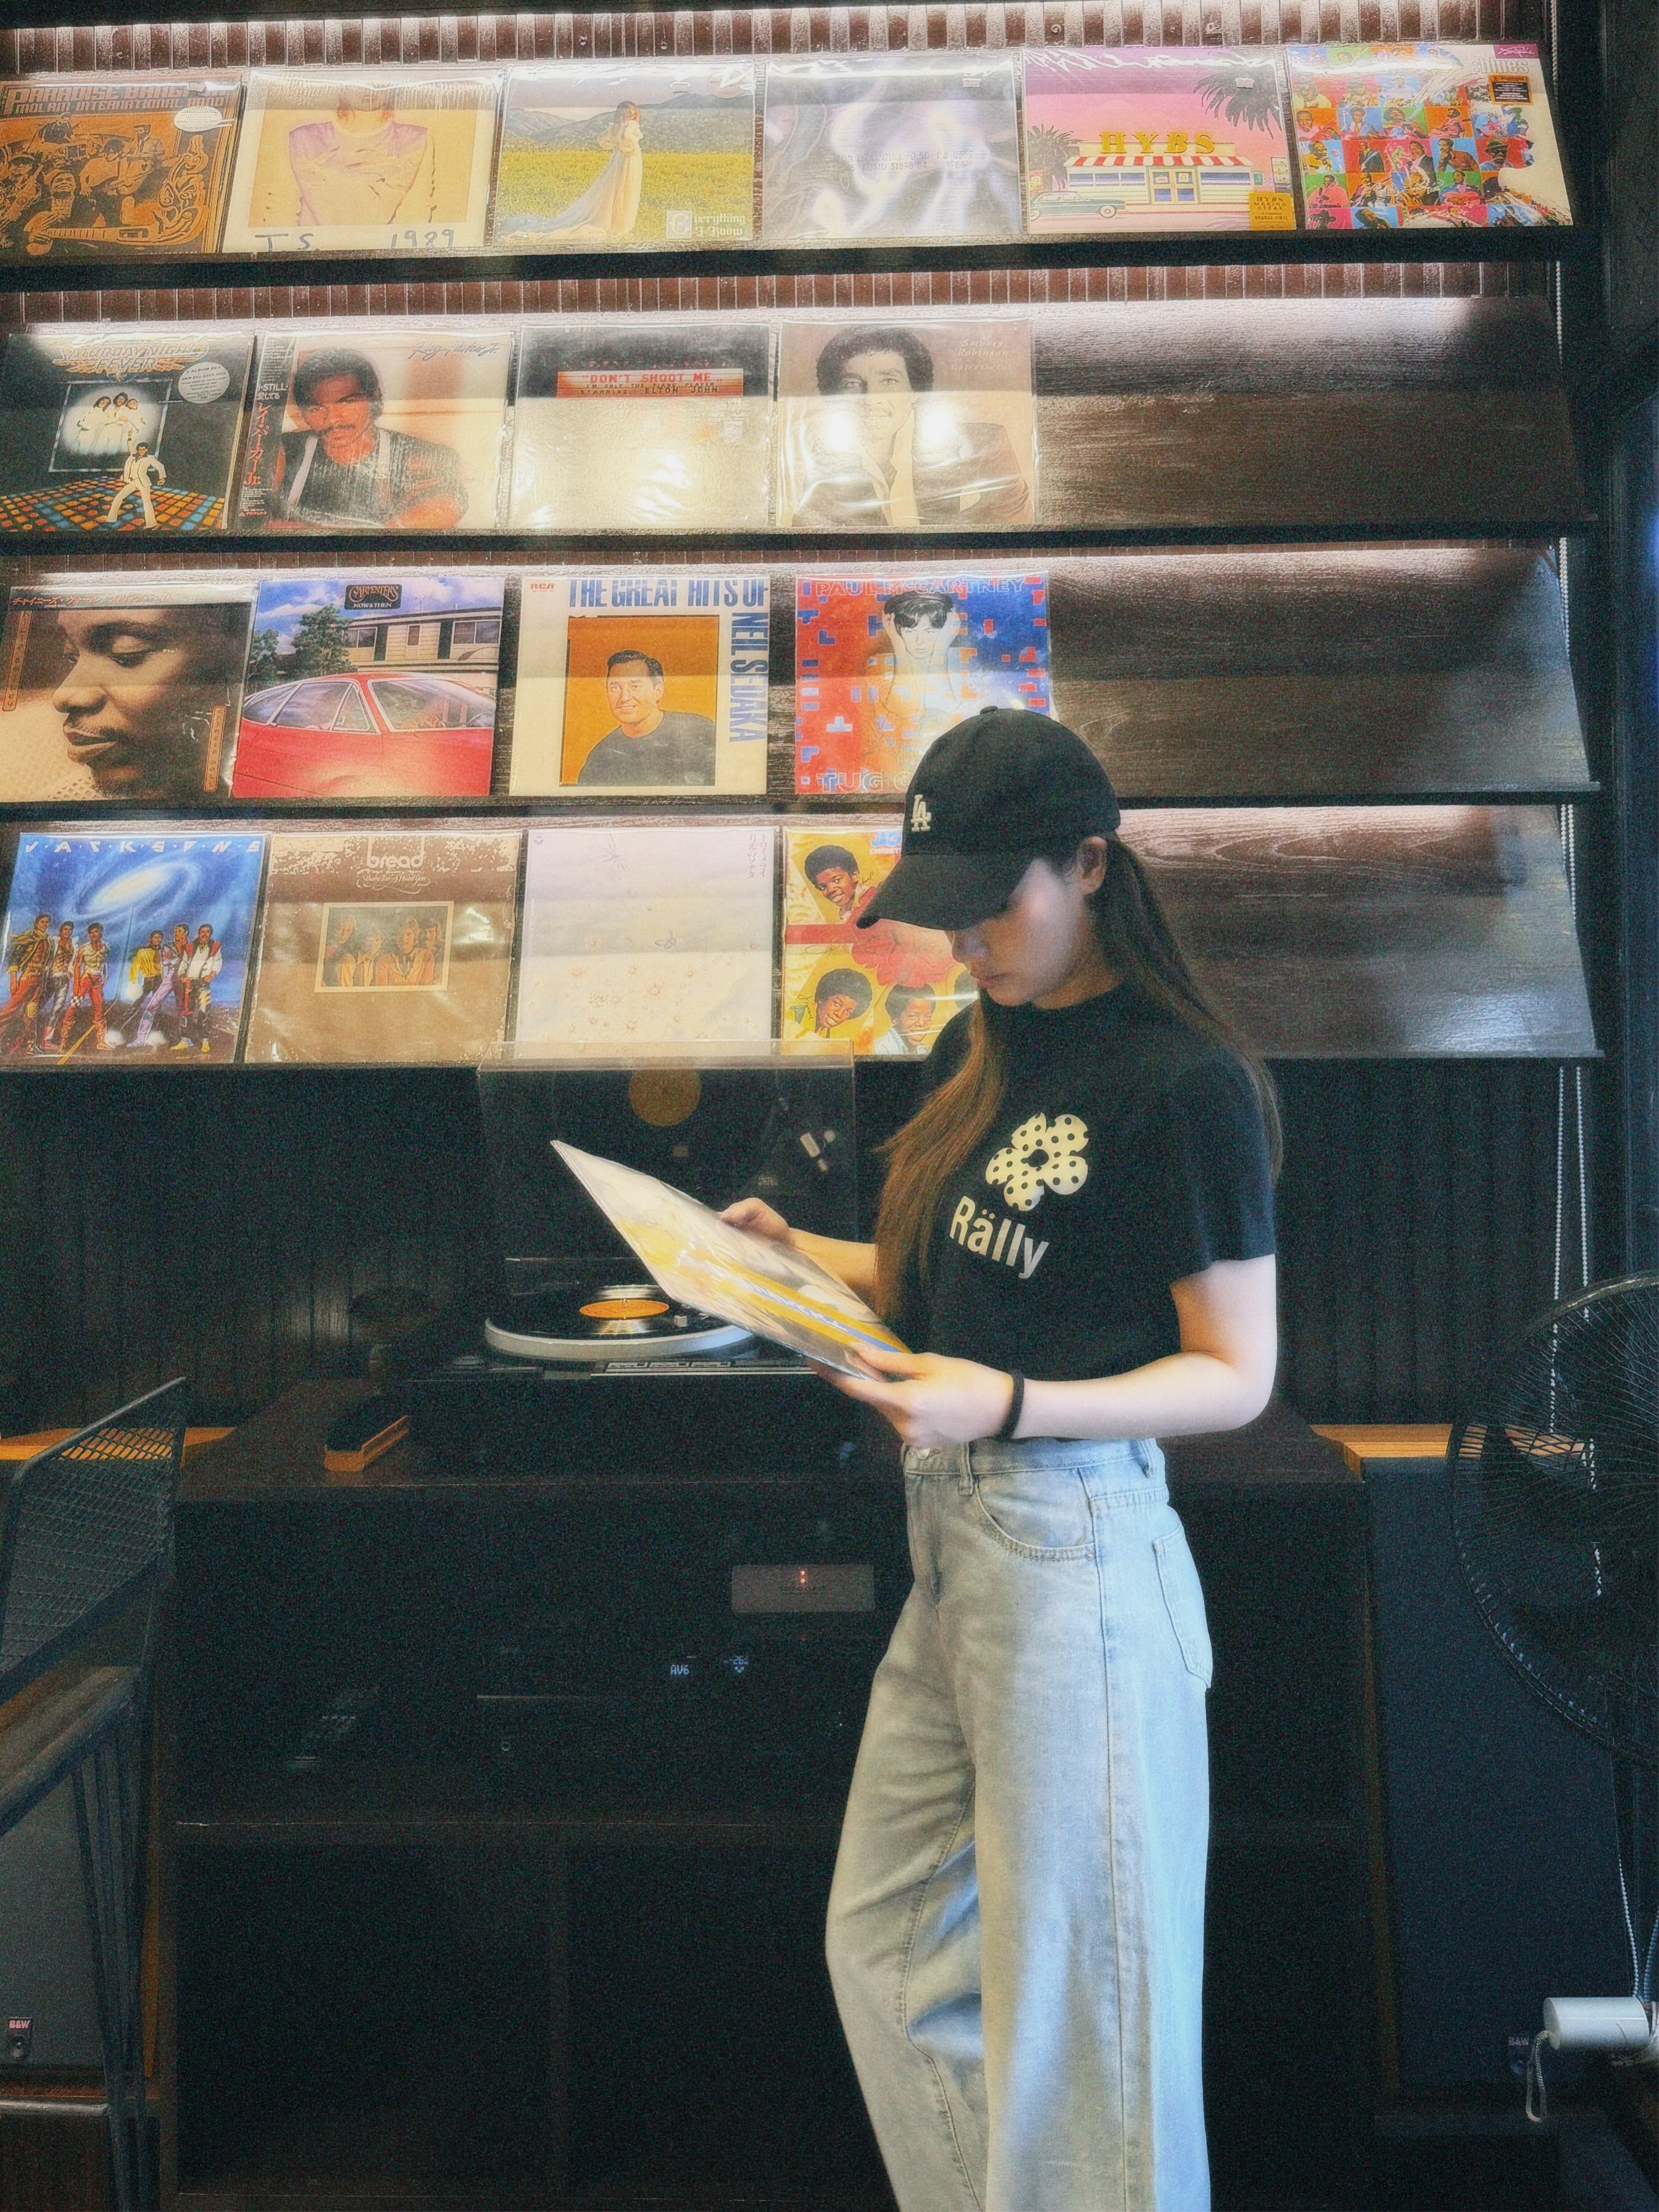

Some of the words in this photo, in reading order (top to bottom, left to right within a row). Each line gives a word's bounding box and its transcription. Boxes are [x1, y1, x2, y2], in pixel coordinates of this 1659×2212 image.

[3, 87, 119, 115] PARADISE
[16, 101, 70, 114] MOLAM
[76, 98, 183, 111] INTERNATIONAL
[1099, 131, 1215, 154] HYBS
[957, 348, 1008, 357] Robinson
[962, 339, 1004, 349] Smokey
[52, 346, 144, 364] SATURDAY
[96, 357, 156, 370] FEVER
[641, 373, 684, 383] SHOOT
[644, 386, 678, 394] ELTON
[691, 386, 717, 394] JOHN
[348, 585, 399, 602] CARPENTERS
[569, 578, 607, 608] THE
[612, 578, 678, 607] GREAT
[688, 578, 738, 607] HITS
[742, 578, 768, 607] OF
[815, 582, 878, 597] PAUL
[731, 612, 769, 656] NEIL
[729, 659, 768, 743] SEDAKA
[816, 771, 883, 793] TUG
[910, 794, 932, 832] LA
[366, 836, 425, 869] bread
[949, 1195, 1049, 1279] Rälly
[670, 1664, 690, 1675] AV6
[9, 2019, 31, 2029] B&W
